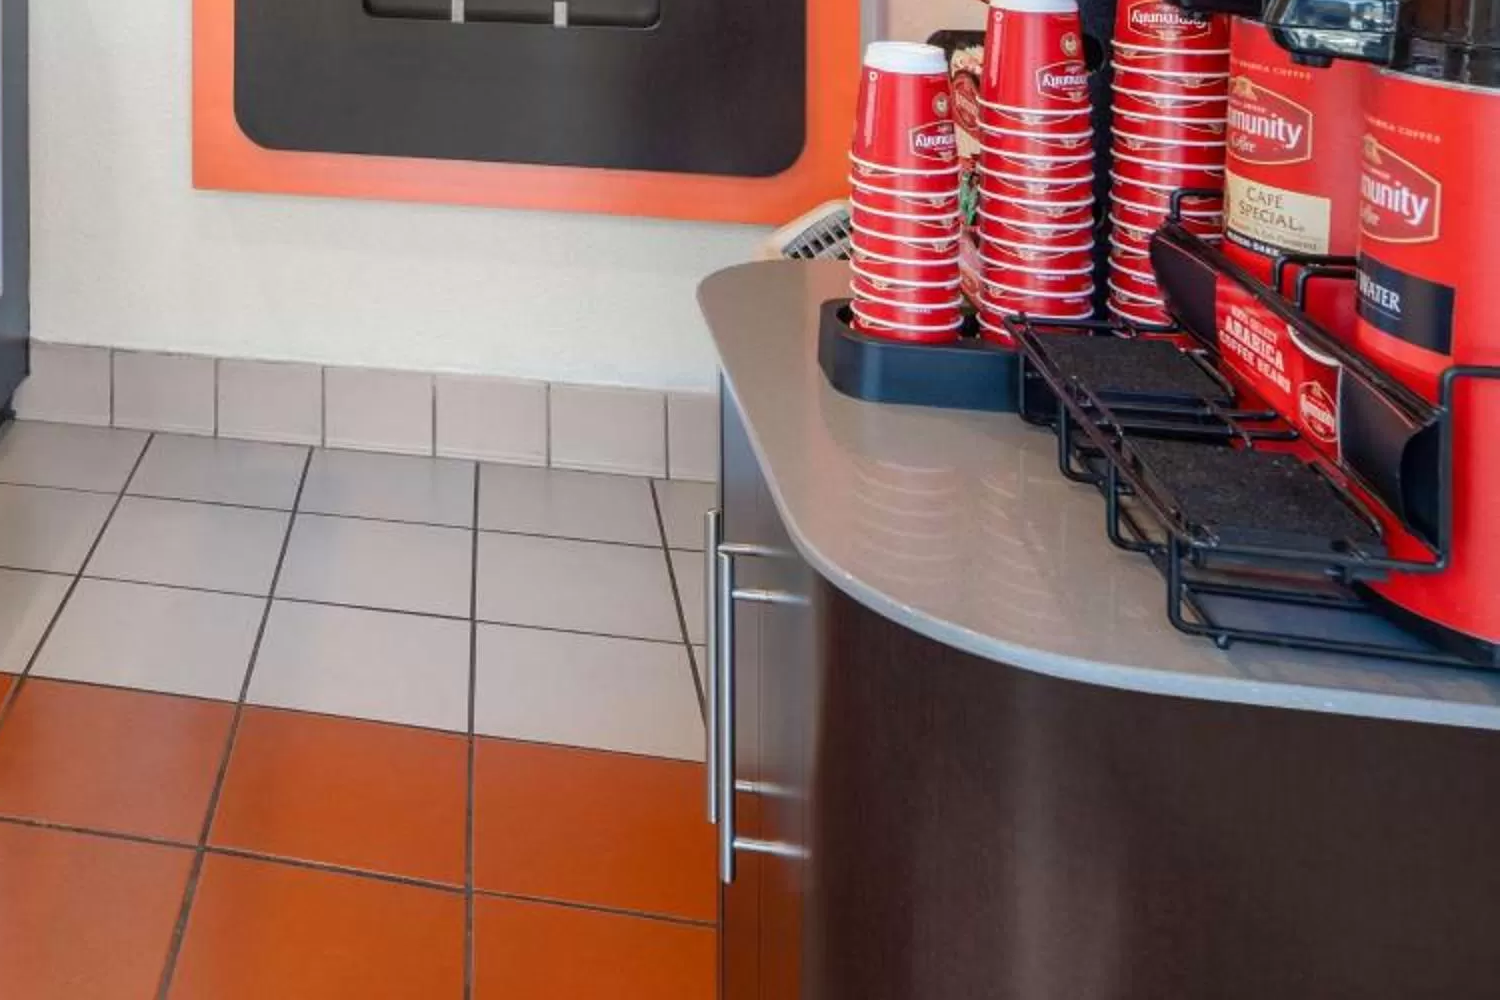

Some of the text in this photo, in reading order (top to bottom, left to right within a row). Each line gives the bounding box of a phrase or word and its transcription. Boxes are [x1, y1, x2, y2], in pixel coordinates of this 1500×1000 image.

[1358, 270, 1401, 313] WATER
[1219, 329, 1291, 395] COFFEE BEANS
[1225, 315, 1284, 373] ARABICA
